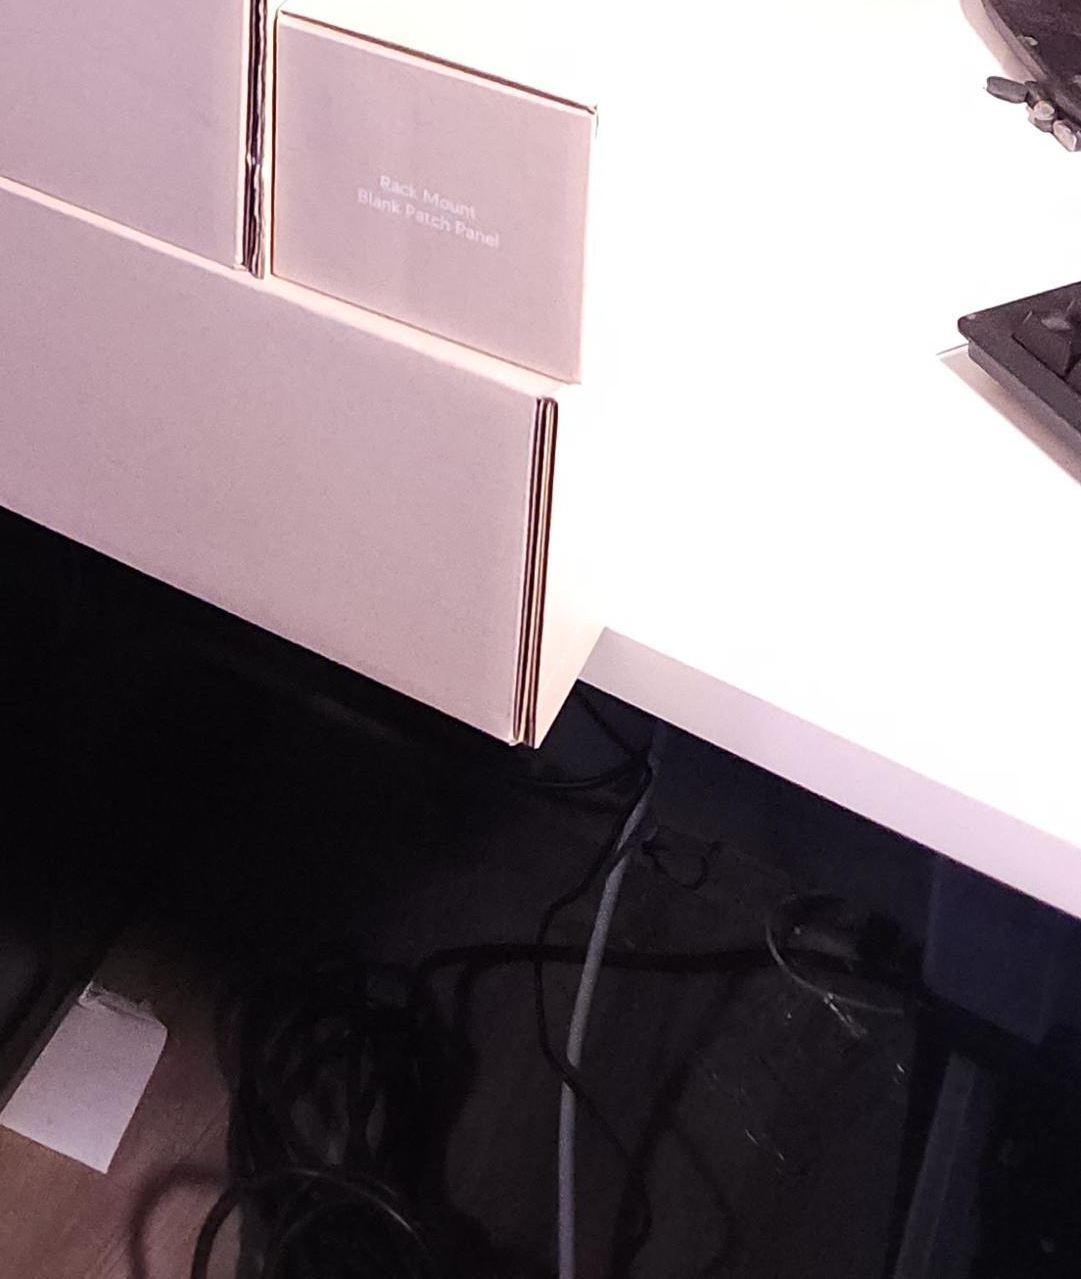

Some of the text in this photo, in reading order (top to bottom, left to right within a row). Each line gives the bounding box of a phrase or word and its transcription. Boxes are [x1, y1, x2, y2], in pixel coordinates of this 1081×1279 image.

[357, 186, 500, 248] Blank Patch Panel
[380, 174, 476, 220] Rack Mount
